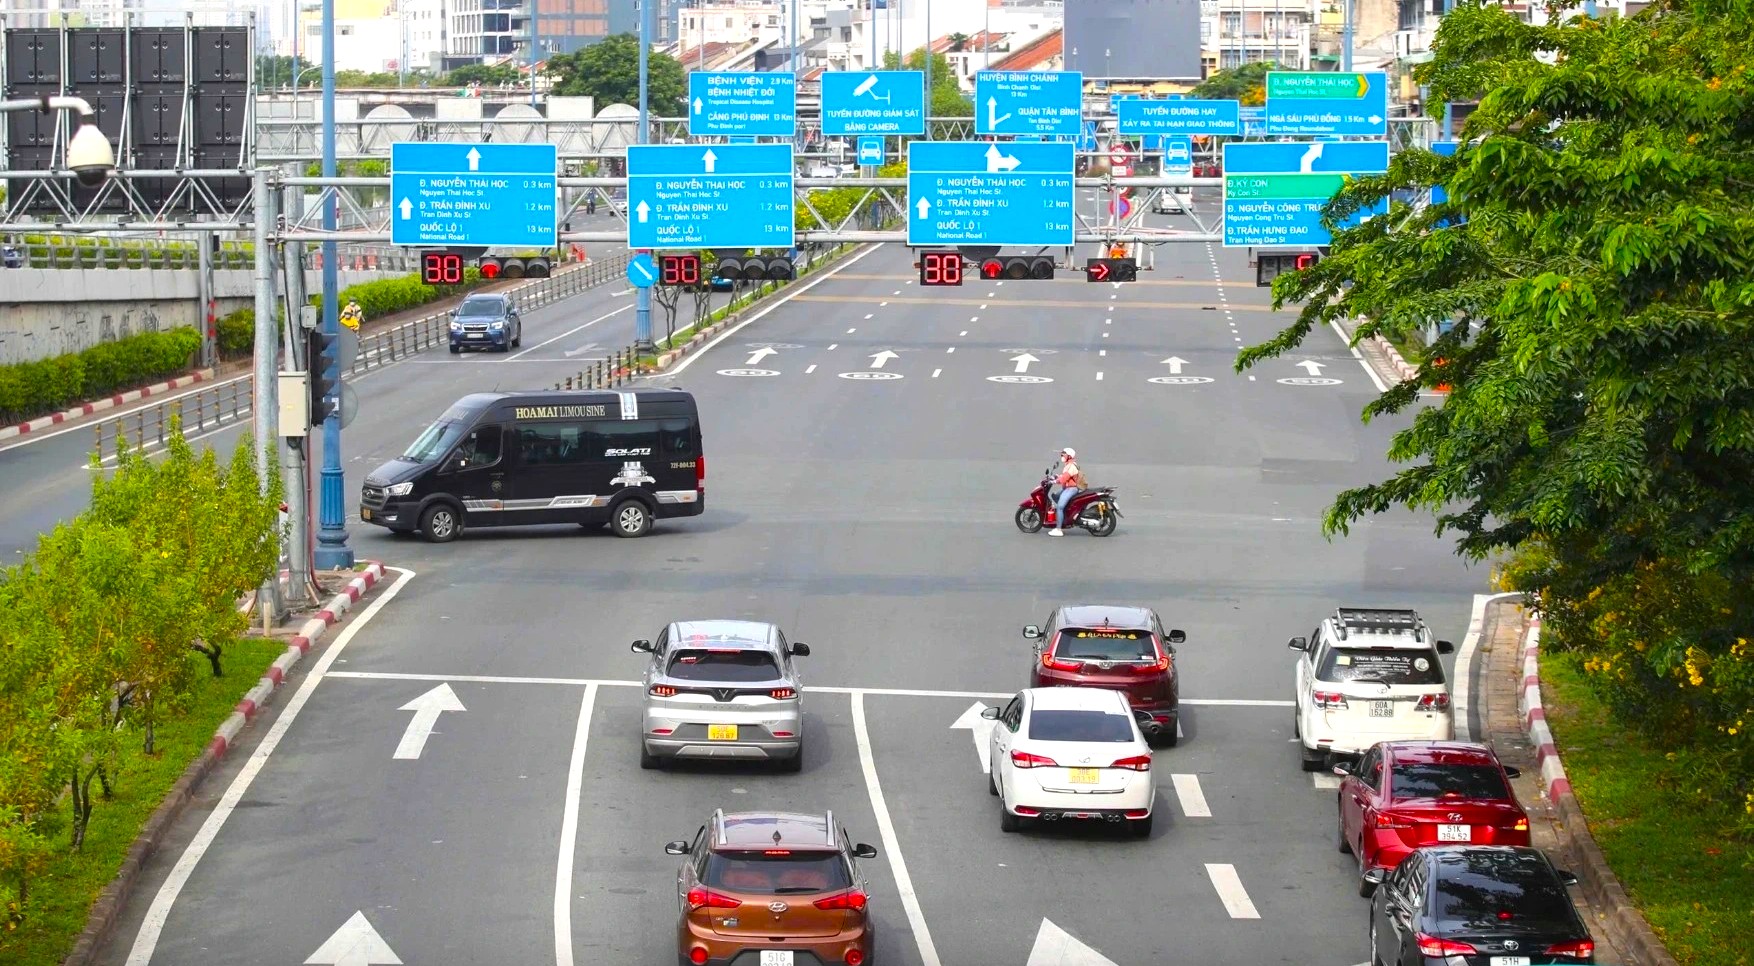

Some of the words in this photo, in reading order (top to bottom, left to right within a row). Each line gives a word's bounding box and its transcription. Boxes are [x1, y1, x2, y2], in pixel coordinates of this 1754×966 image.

[708, 76, 736, 86] BỆNH
[740, 76, 763, 86] VIỆN
[708, 86, 731, 97] BỆNH
[734, 87, 758, 97] NHIỆT
[431, 177, 466, 187] NGUYỄN
[491, 180, 508, 189] HỌC
[667, 178, 703, 189] NGUYỄN
[728, 181, 745, 190] HỌC
[948, 176, 984, 186] NGUYỄN
[1009, 179, 1026, 188] HỌC
[1239, 201, 1274, 212] NGUYỄN
[1277, 203, 1301, 212] CÔNG
[446, 223, 457, 233] LỘ
[683, 225, 694, 235] LỘ
[964, 220, 975, 231] LỘ
[1290, 227, 1308, 236] ĐẠO
[426, 256, 460, 282] 30
[664, 257, 698, 283] 30
[925, 256, 959, 282] 30
[560, 405, 605, 417] LIMOUSINE
[768, 952, 785, 962] 51G
[1502, 957, 1518, 966] 51H
